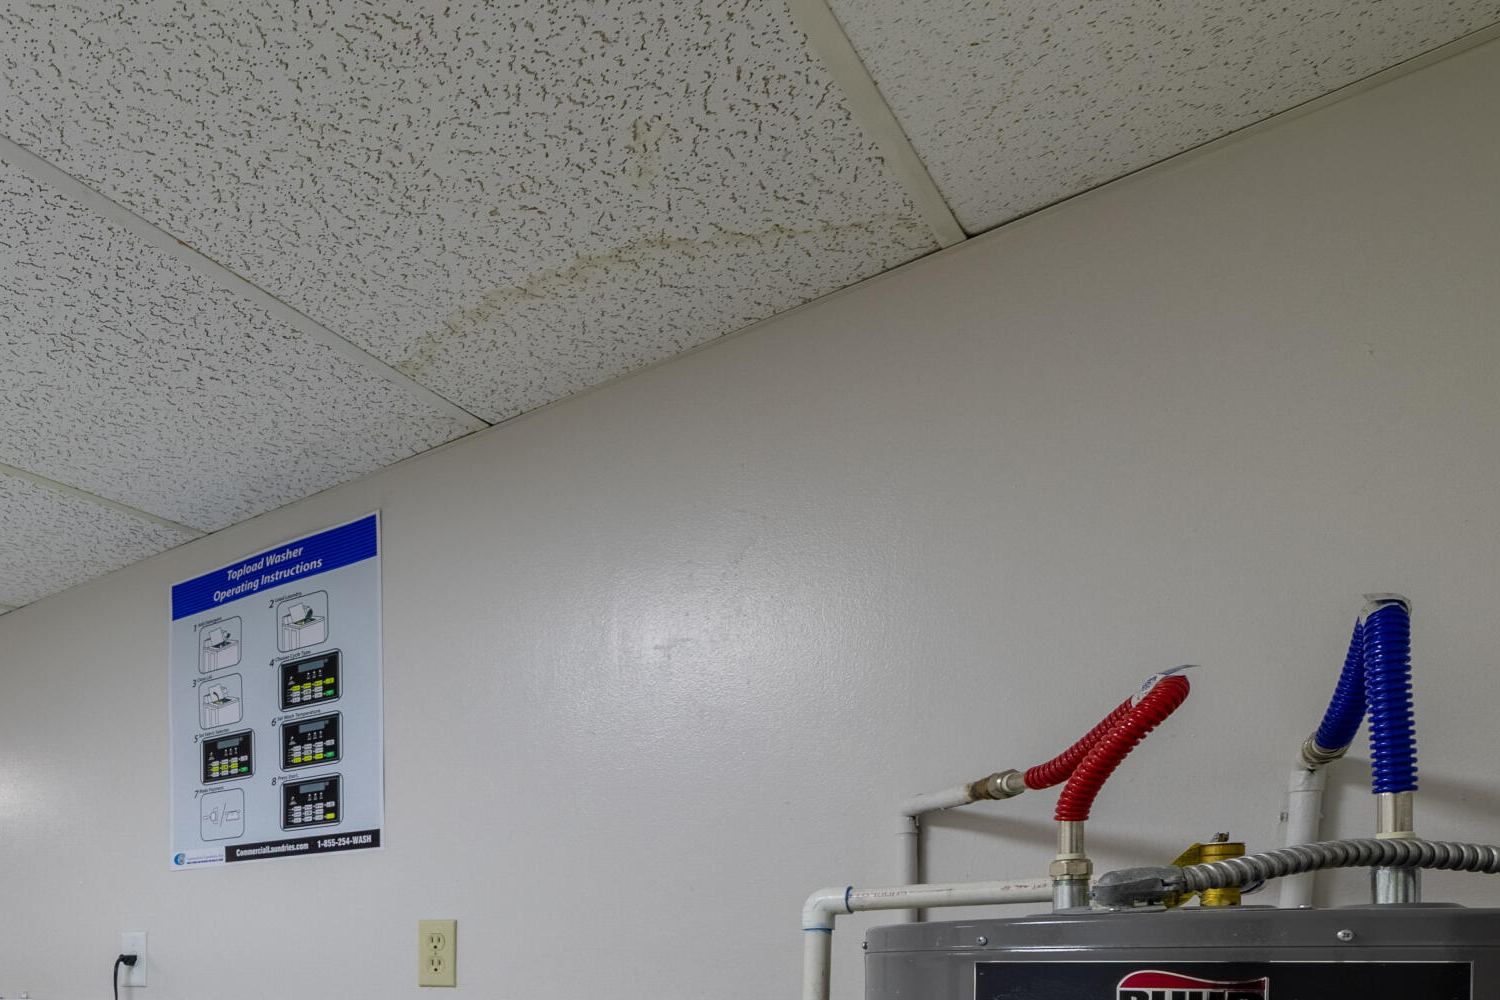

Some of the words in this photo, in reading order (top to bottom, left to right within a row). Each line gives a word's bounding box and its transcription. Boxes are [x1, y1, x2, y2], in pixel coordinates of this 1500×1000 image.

[227, 557, 263, 583] Topload
[266, 542, 303, 567] Washer
[213, 575, 259, 604] Operating
[261, 554, 322, 586] Instructions
[268, 598, 273, 609] 2
[193, 624, 196, 633] 1
[269, 658, 274, 668] 4
[192, 679, 196, 687] 3
[271, 717, 276, 727] 6
[193, 734, 198, 743] 5
[271, 776, 276, 786] 8
[194, 789, 198, 799] 7
[236, 840, 308, 857] CommercialLaundries.com
[316, 833, 371, 848] 1-855-254-WASH
